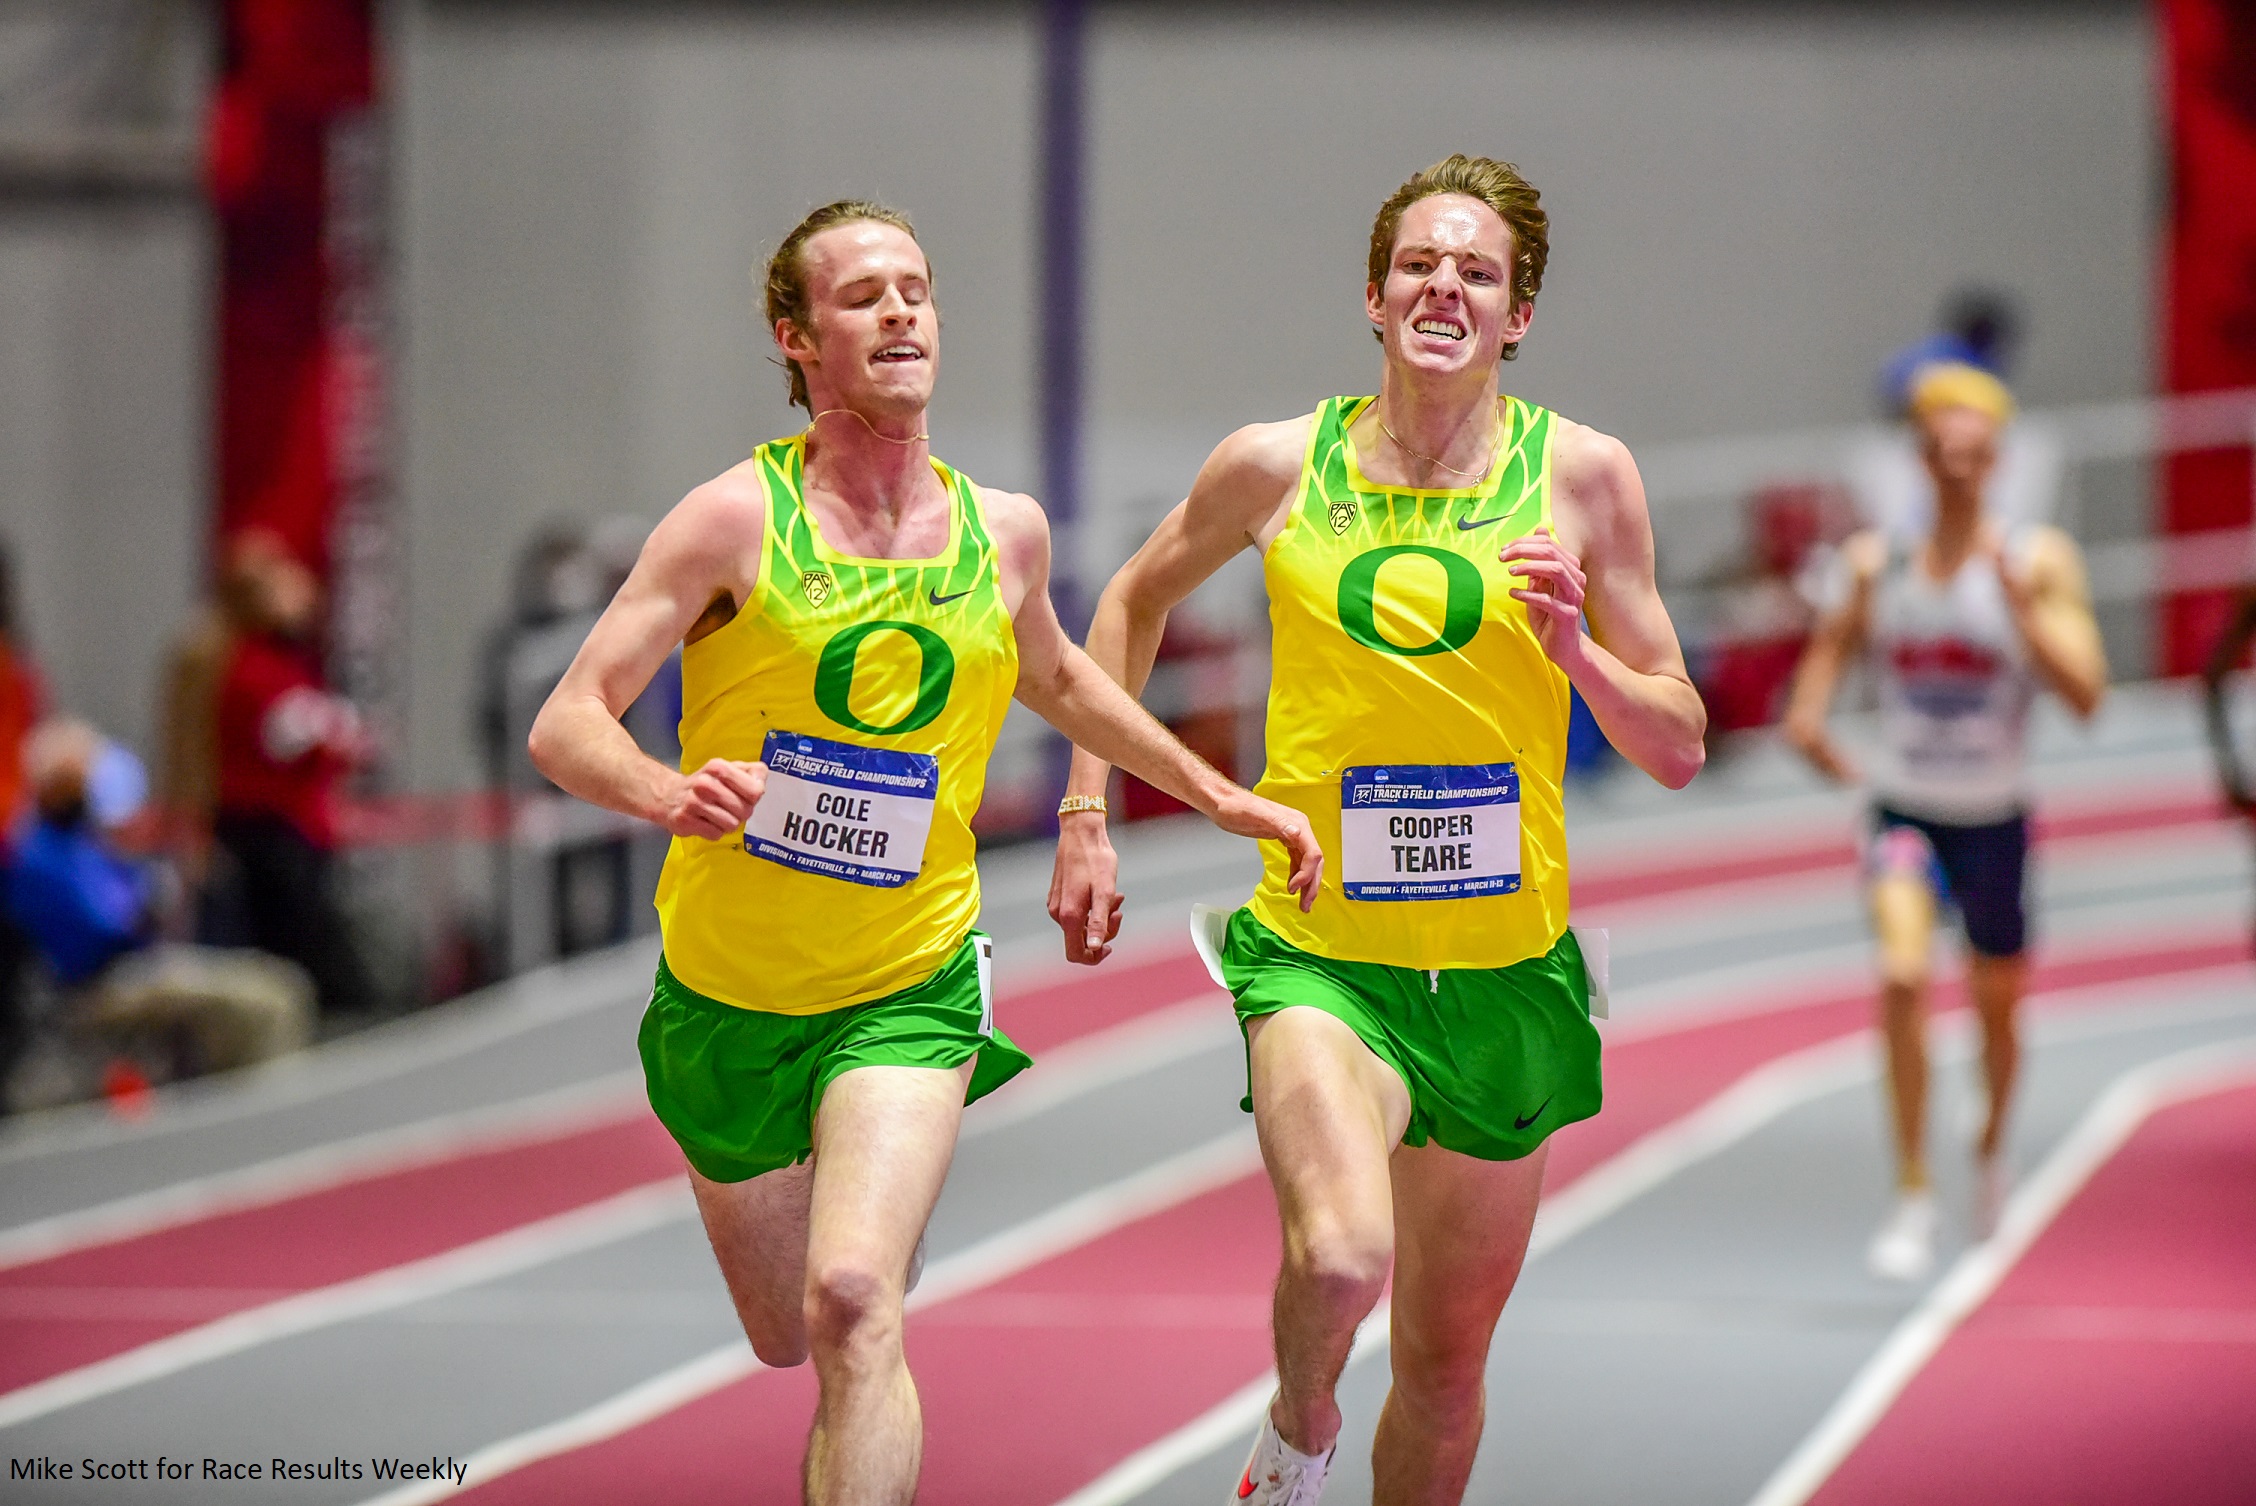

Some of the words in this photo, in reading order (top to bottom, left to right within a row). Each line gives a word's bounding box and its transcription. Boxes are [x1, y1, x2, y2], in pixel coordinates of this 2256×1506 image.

[1330, 503, 1356, 521] PAC
[1333, 515, 1347, 528] 12
[804, 573, 830, 592] PAC
[809, 588, 823, 601] 12
[1337, 544, 1484, 656] O
[814, 621, 955, 736] O
[793, 758, 822, 773] TRACK
[821, 765, 830, 774] &
[830, 767, 854, 780] FIELD
[855, 771, 926, 789] CHAMPIONSHIPS
[816, 792, 871, 821] COLE
[1374, 789, 1402, 799] TRACK
[1402, 789, 1409, 799] &
[1410, 790, 1434, 800] FIELD
[1435, 786, 1508, 800] CHAMPIONSHIPS
[782, 811, 889, 858] HOCKER
[1389, 814, 1473, 839] COOPER
[758, 843, 789, 860] DIVISION
[797, 856, 844, 874] FAYETTEVILLE,
[845, 867, 856, 875] AR
[861, 869, 885, 880] MARCH
[885, 873, 901, 882] 11-13
[1391, 843, 1472, 873] TEARE
[1361, 887, 1392, 895] DIVISION
[1401, 885, 1448, 894] FAYETTEVILLE,
[1449, 884, 1459, 892] AR
[1464, 882, 1488, 891] MARCH
[1489, 880, 1504, 889] 11-13
